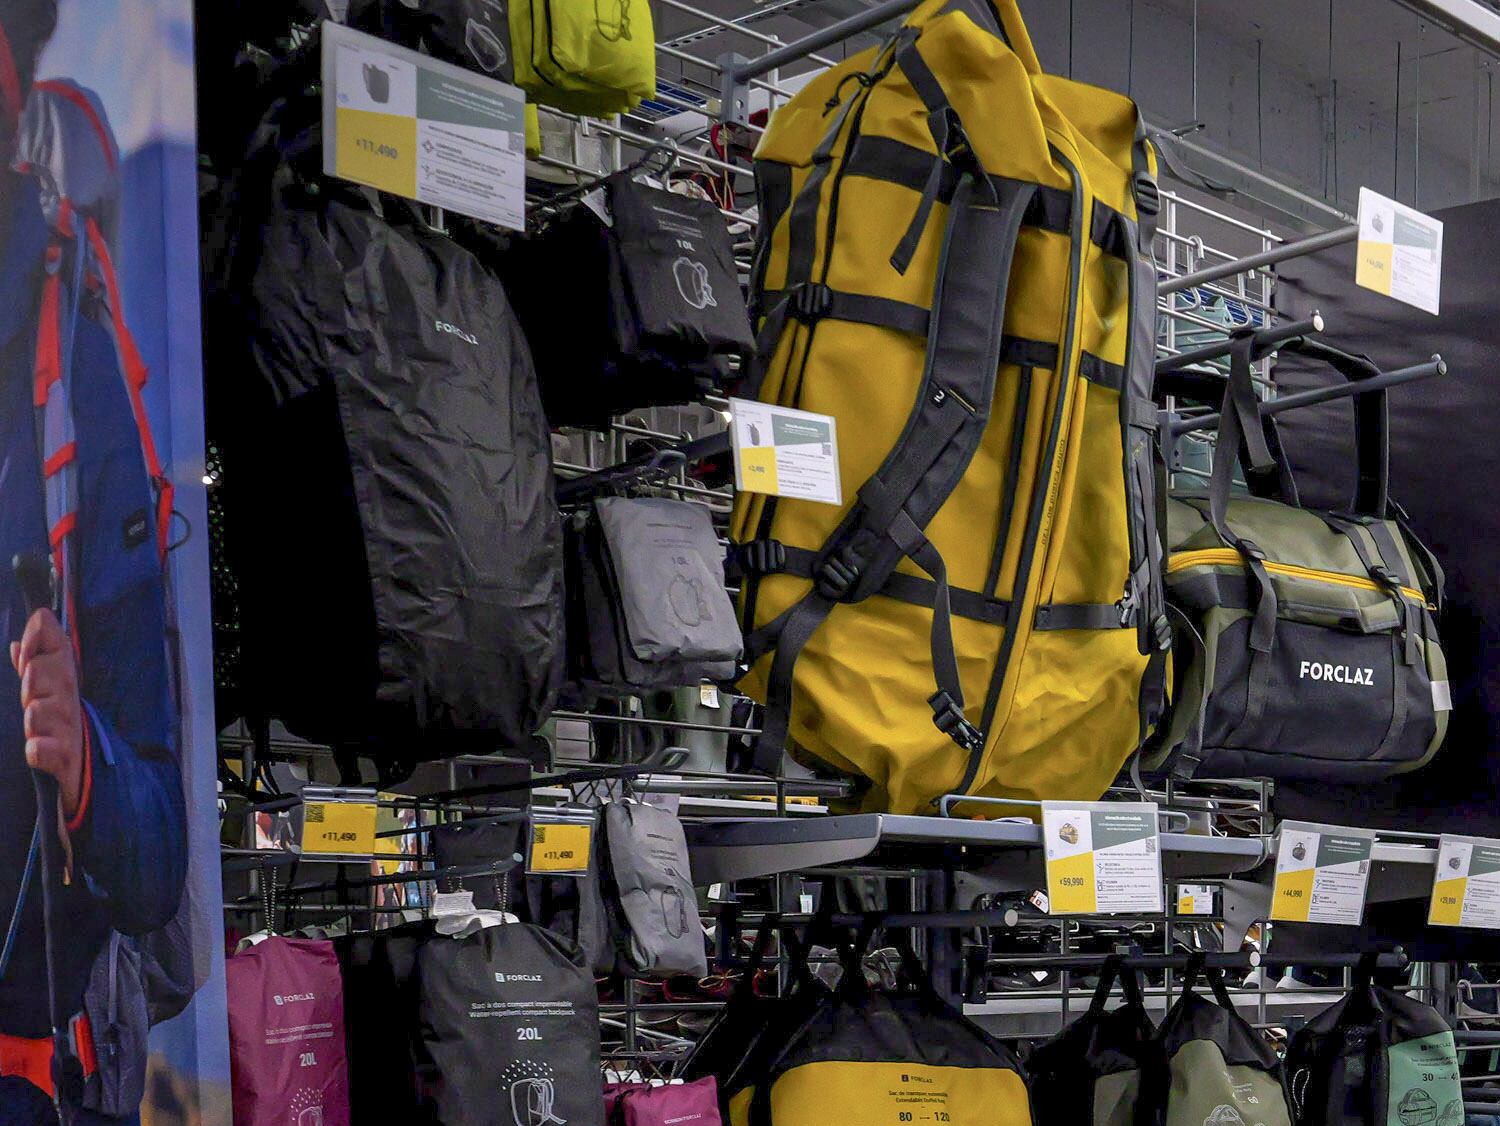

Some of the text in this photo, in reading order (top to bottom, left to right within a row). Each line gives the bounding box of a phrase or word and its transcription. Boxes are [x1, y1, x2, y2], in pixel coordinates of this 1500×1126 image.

[676, 239, 695, 251] 10L
[1300, 660, 1374, 686] FORCLAZ
[506, 974, 542, 982] FORCLAZ
[283, 992, 315, 1003] FORCLAZ
[516, 1027, 543, 1040] 20L
[299, 1052, 317, 1067] 20L
[1422, 1072, 1434, 1082] 30
[899, 1111, 912, 1121] 80
